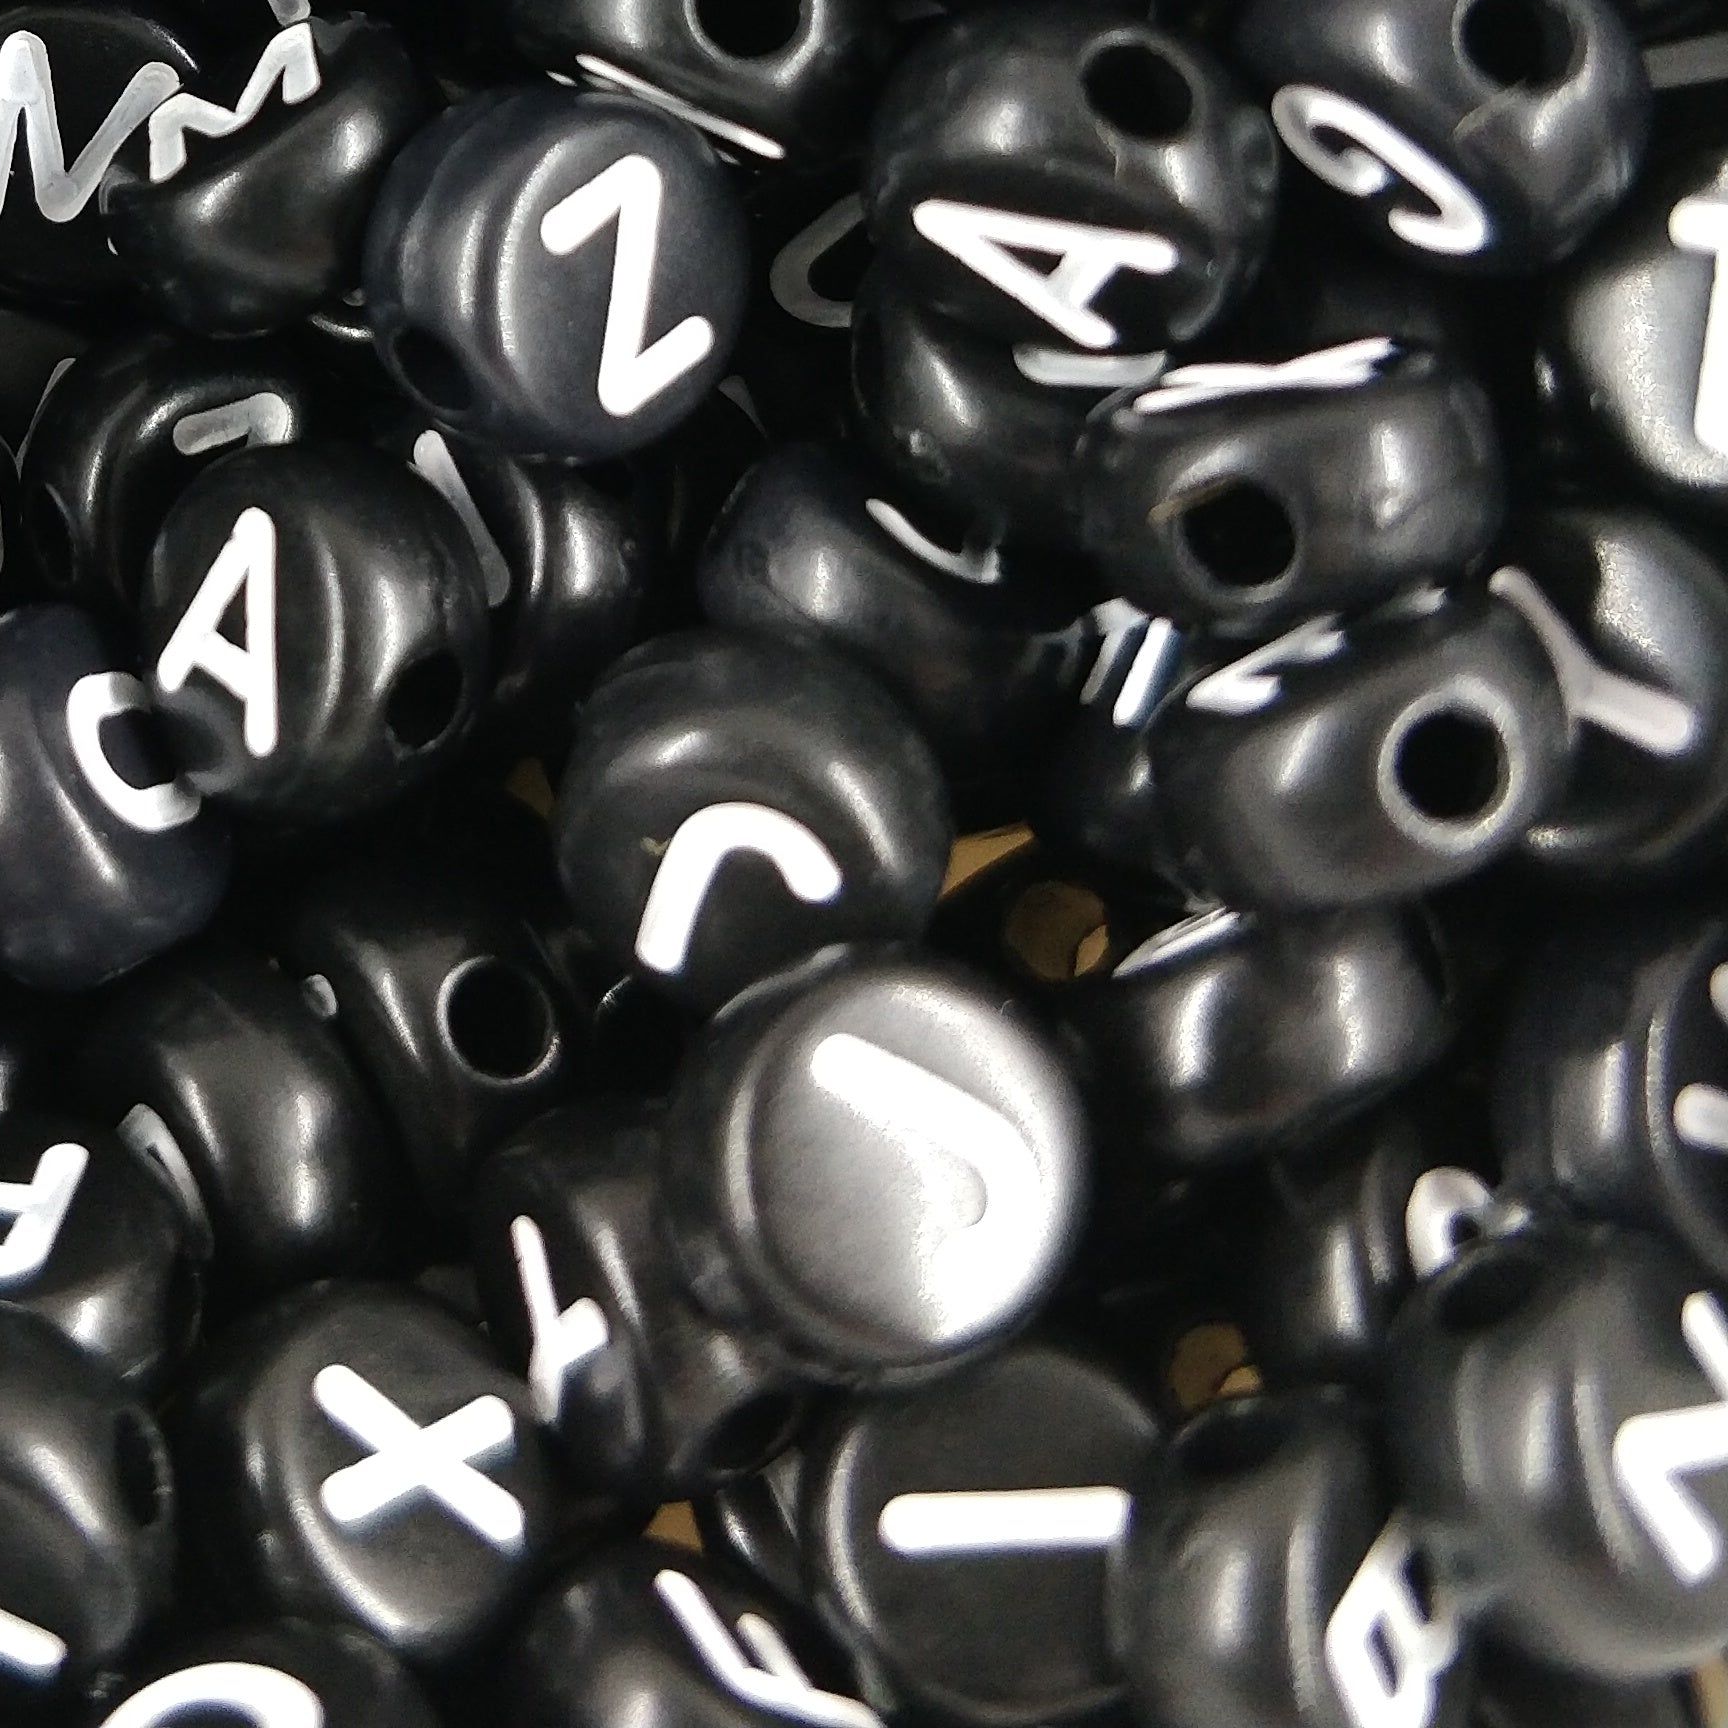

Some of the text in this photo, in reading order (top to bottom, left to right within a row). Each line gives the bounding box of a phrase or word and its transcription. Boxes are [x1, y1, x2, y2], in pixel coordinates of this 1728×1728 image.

[543, 157, 714, 415] Z
[914, 201, 1178, 348] A
[157, 508, 278, 757] A
[313, 1366, 524, 1551] X
[879, 1487, 1130, 1554] I
